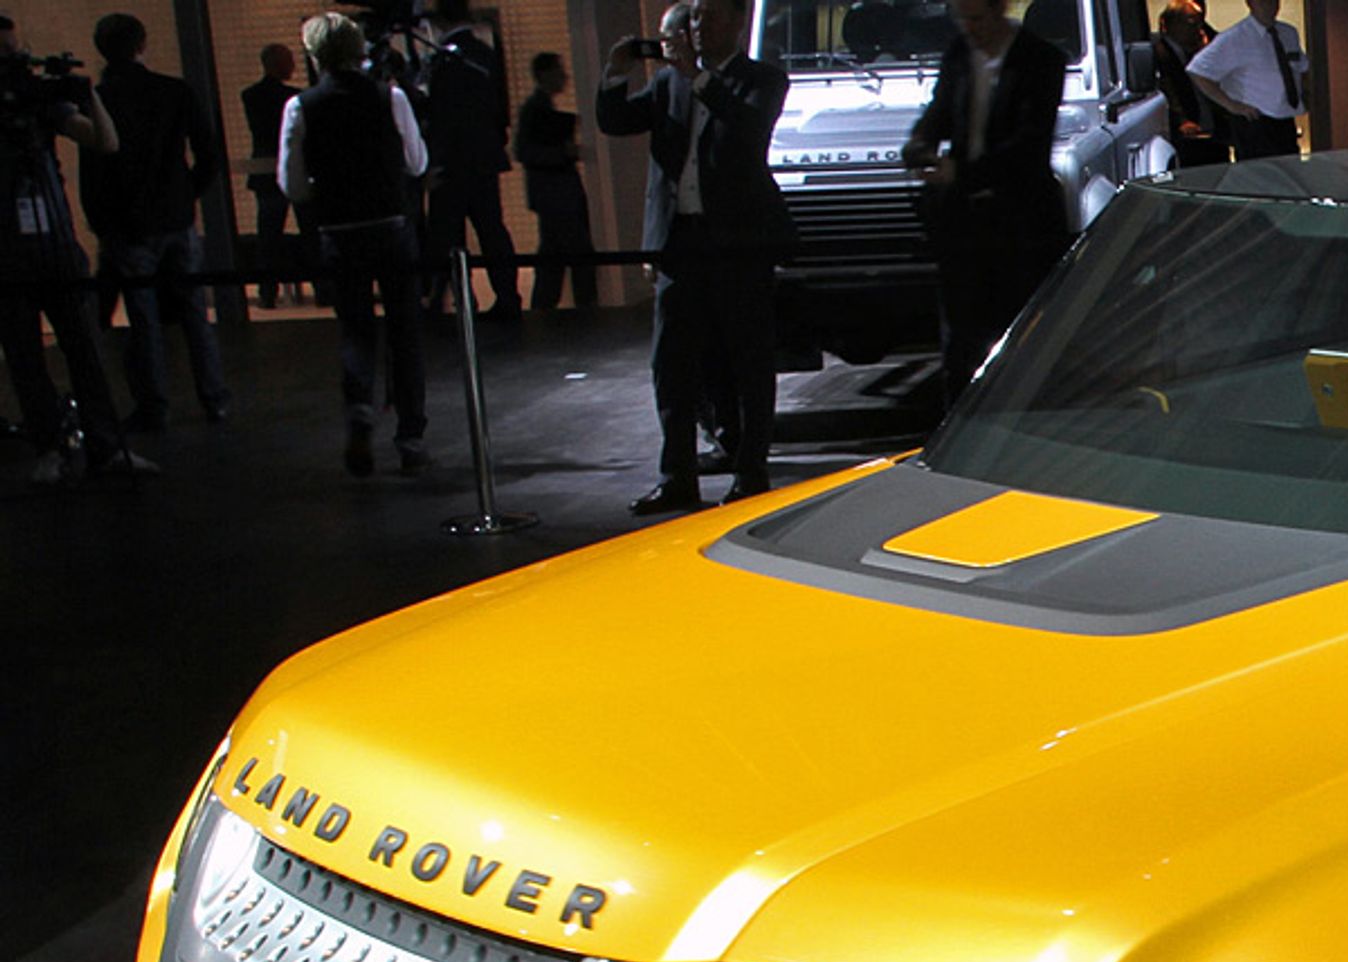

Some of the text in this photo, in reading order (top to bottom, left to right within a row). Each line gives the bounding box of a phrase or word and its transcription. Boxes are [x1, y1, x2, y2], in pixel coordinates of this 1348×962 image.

[782, 151, 850, 164] LAND
[233, 757, 609, 930] LAND ROVER
